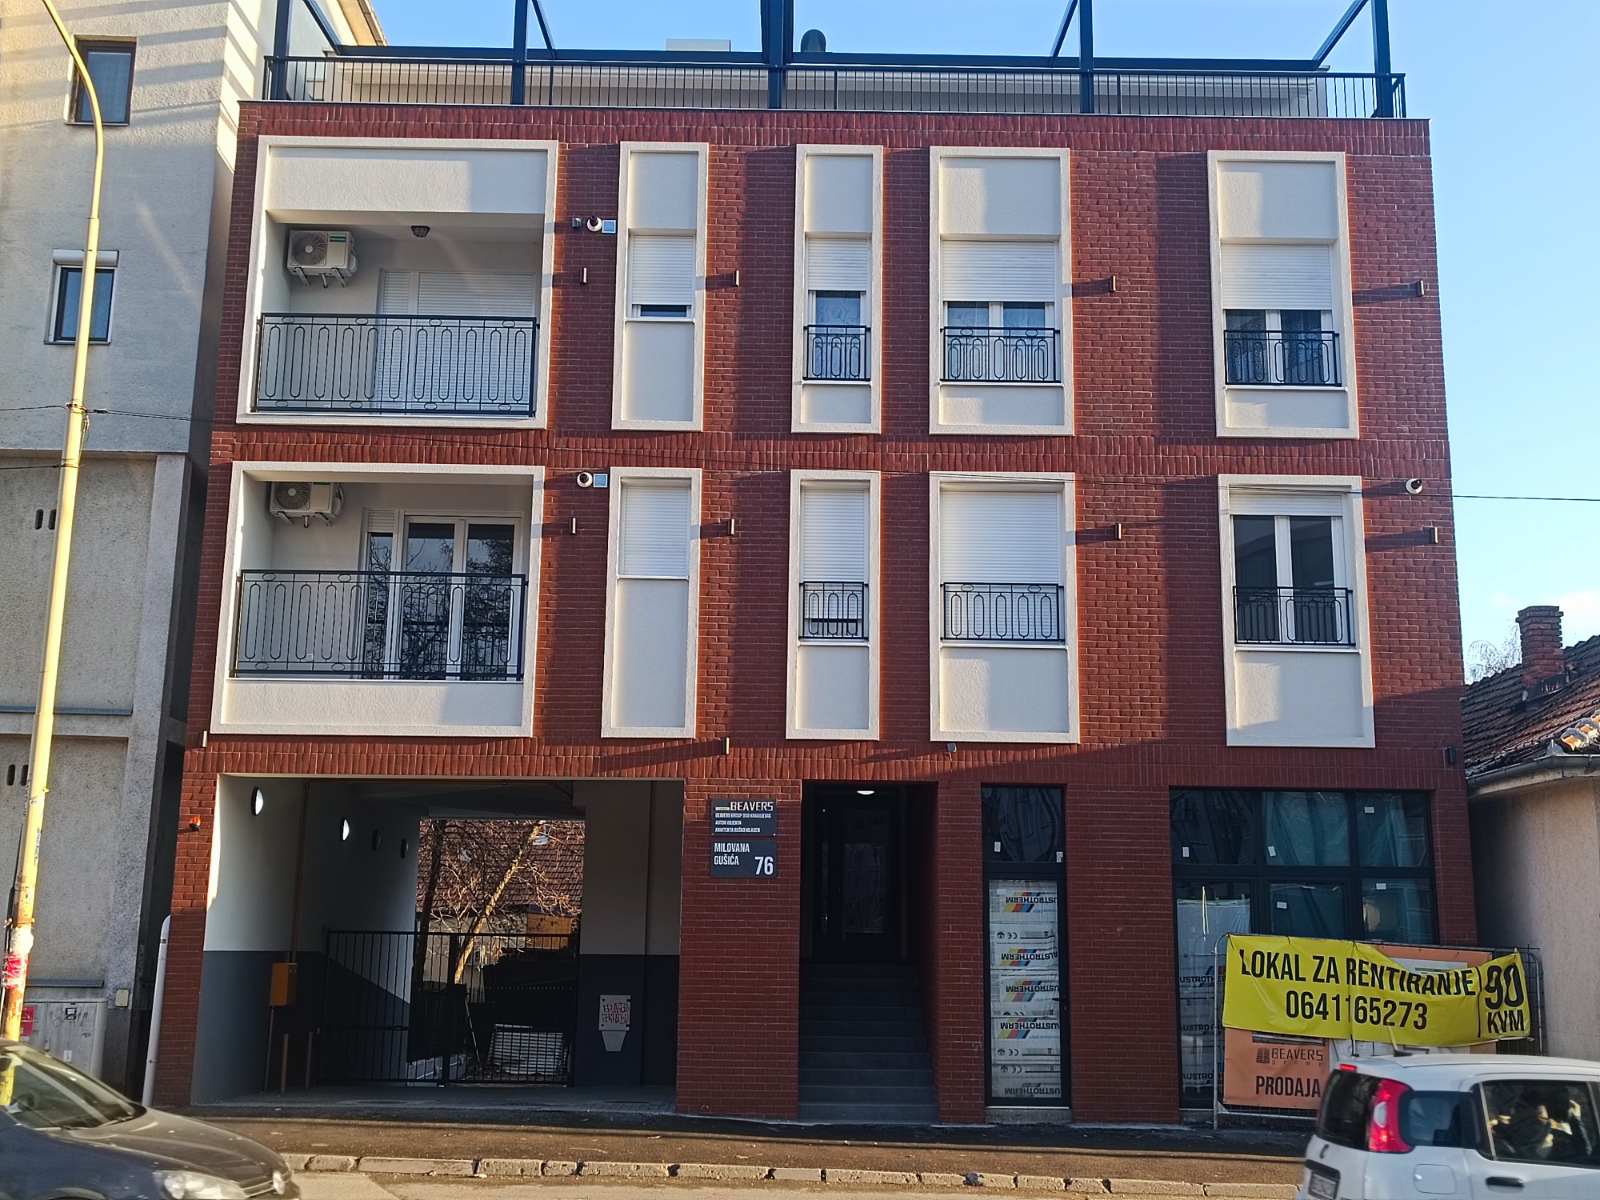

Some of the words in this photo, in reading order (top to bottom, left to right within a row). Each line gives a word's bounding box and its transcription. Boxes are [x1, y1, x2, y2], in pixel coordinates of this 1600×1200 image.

[730, 801, 774, 811] BEAVERS
[714, 842, 751, 853] MILOVANA
[754, 856, 774, 876] 76
[1005, 896, 1057, 904] STROTHERM
[1239, 949, 1307, 982] LOKAL
[1312, 955, 1340, 985] ZA
[1345, 957, 1476, 996] RENTIRANJE
[1484, 962, 1524, 1010] 90
[1286, 990, 1428, 1031] 0641165273
[1487, 1009, 1525, 1034] KVM
[1271, 1047, 1324, 1062] BEAVERS
[1255, 1074, 1321, 1098] PRODAJA
